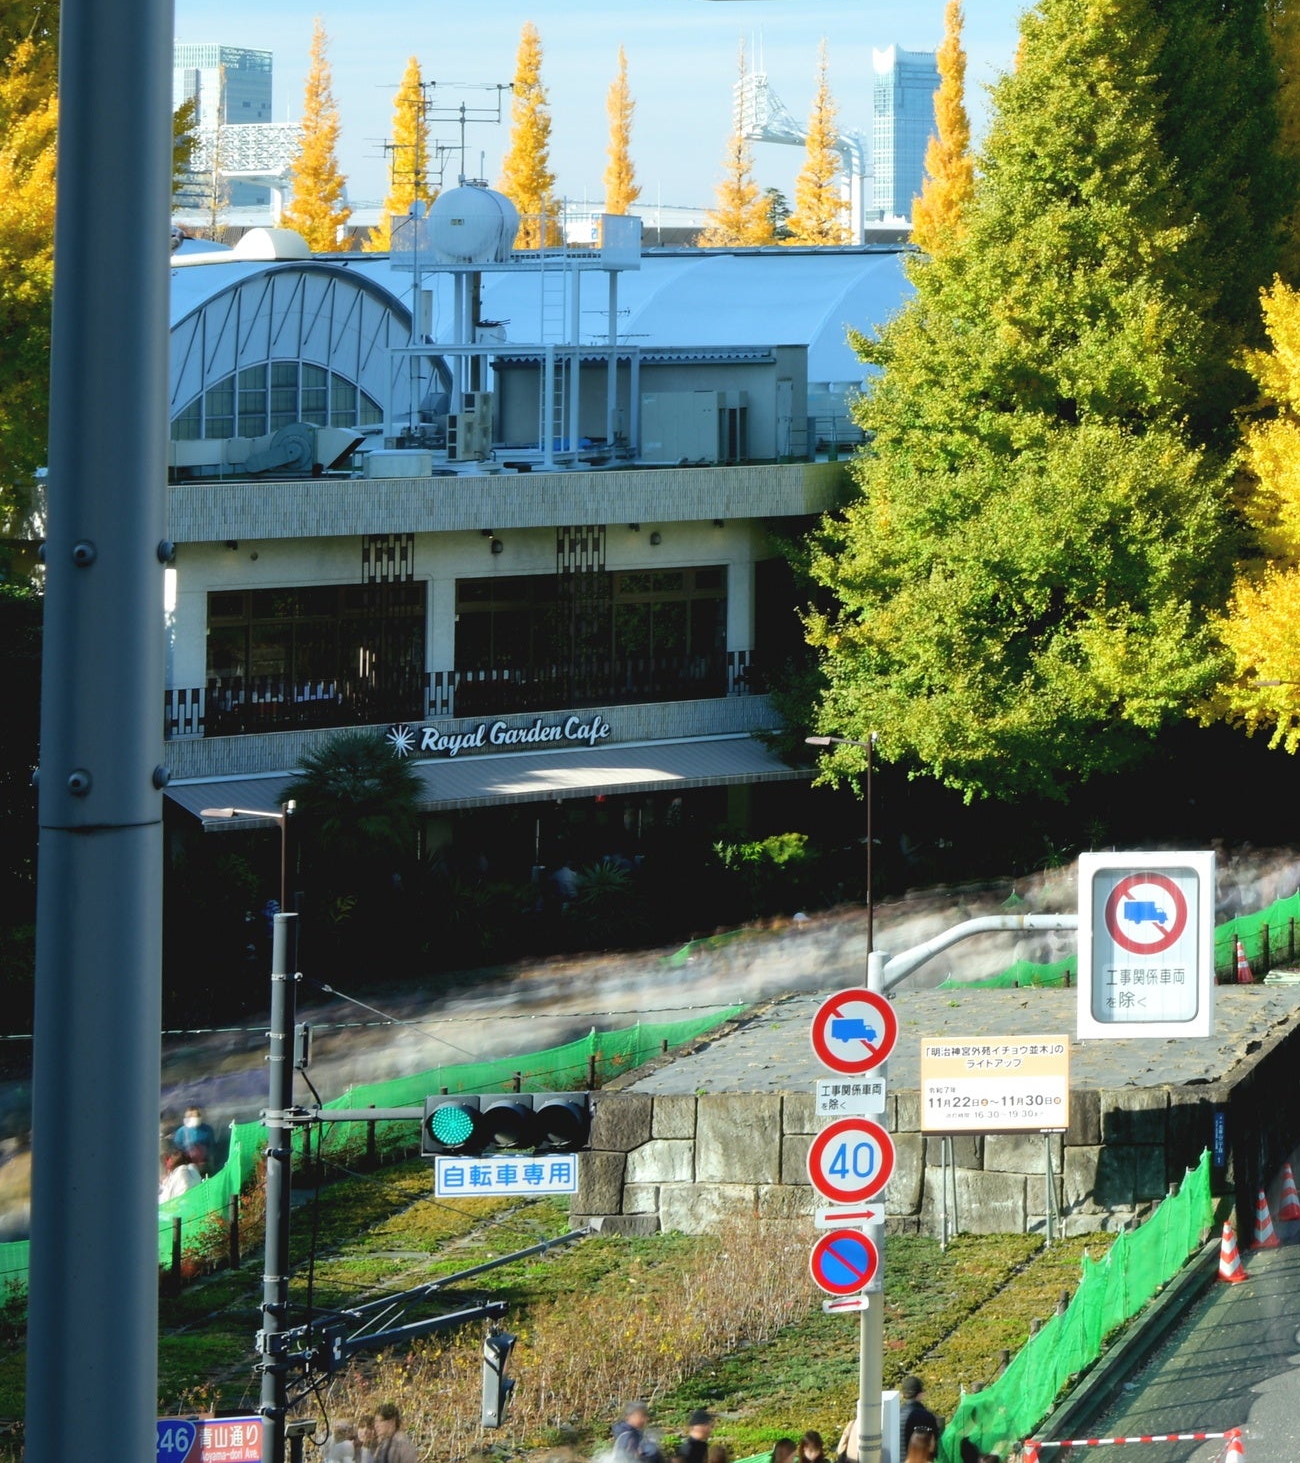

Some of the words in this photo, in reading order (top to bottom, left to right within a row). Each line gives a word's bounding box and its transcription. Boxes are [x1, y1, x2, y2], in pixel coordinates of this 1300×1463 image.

[420, 724, 486, 757] Royal
[490, 719, 562, 745] Garden
[564, 716, 611, 745] Cafe
[1106, 968, 1185, 986] 工事関係車両
[1106, 991, 1147, 1008] を除く
[821, 1083, 882, 1097] 工事関係車両
[821, 1098, 847, 1111] を除く
[829, 1142, 874, 1179] 40
[444, 1163, 571, 1188] 自転車専用
[157, 1427, 189, 1453] 46
[200, 1424, 259, 1449] 青山通り
[246, 1447, 260, 1459] Ave.
